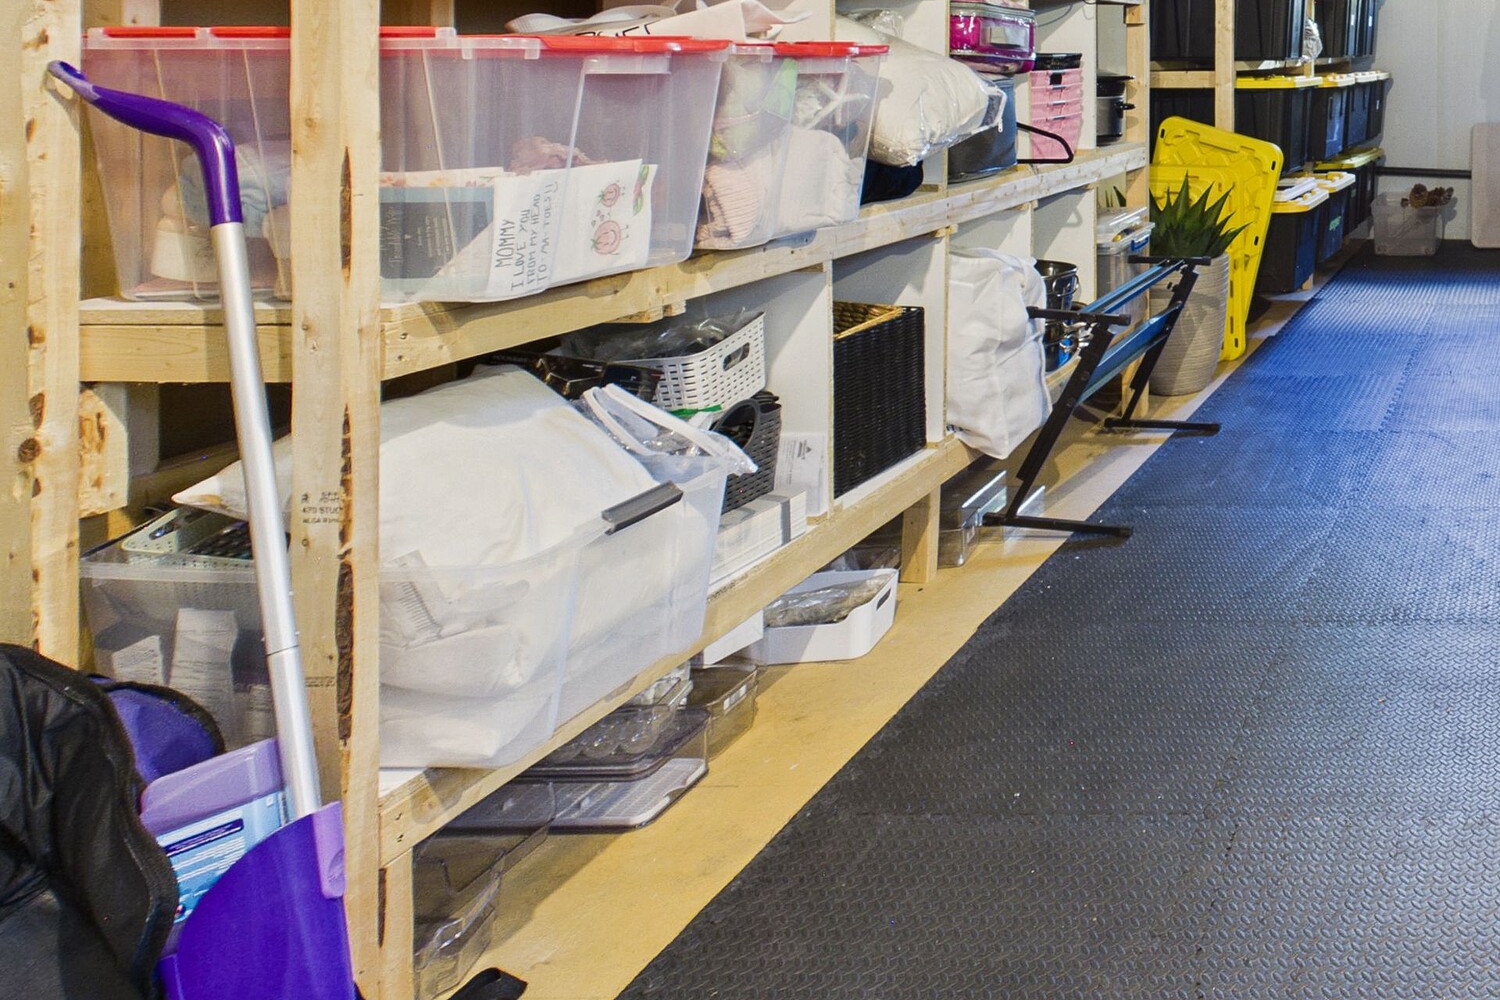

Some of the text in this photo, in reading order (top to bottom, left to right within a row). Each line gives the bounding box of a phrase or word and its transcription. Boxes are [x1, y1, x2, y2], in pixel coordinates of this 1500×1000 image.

[496, 219, 516, 268] MOMMY
[511, 209, 531, 291] I LOVE YOU
[530, 230, 539, 246] MY
[526, 251, 536, 285] FROM
